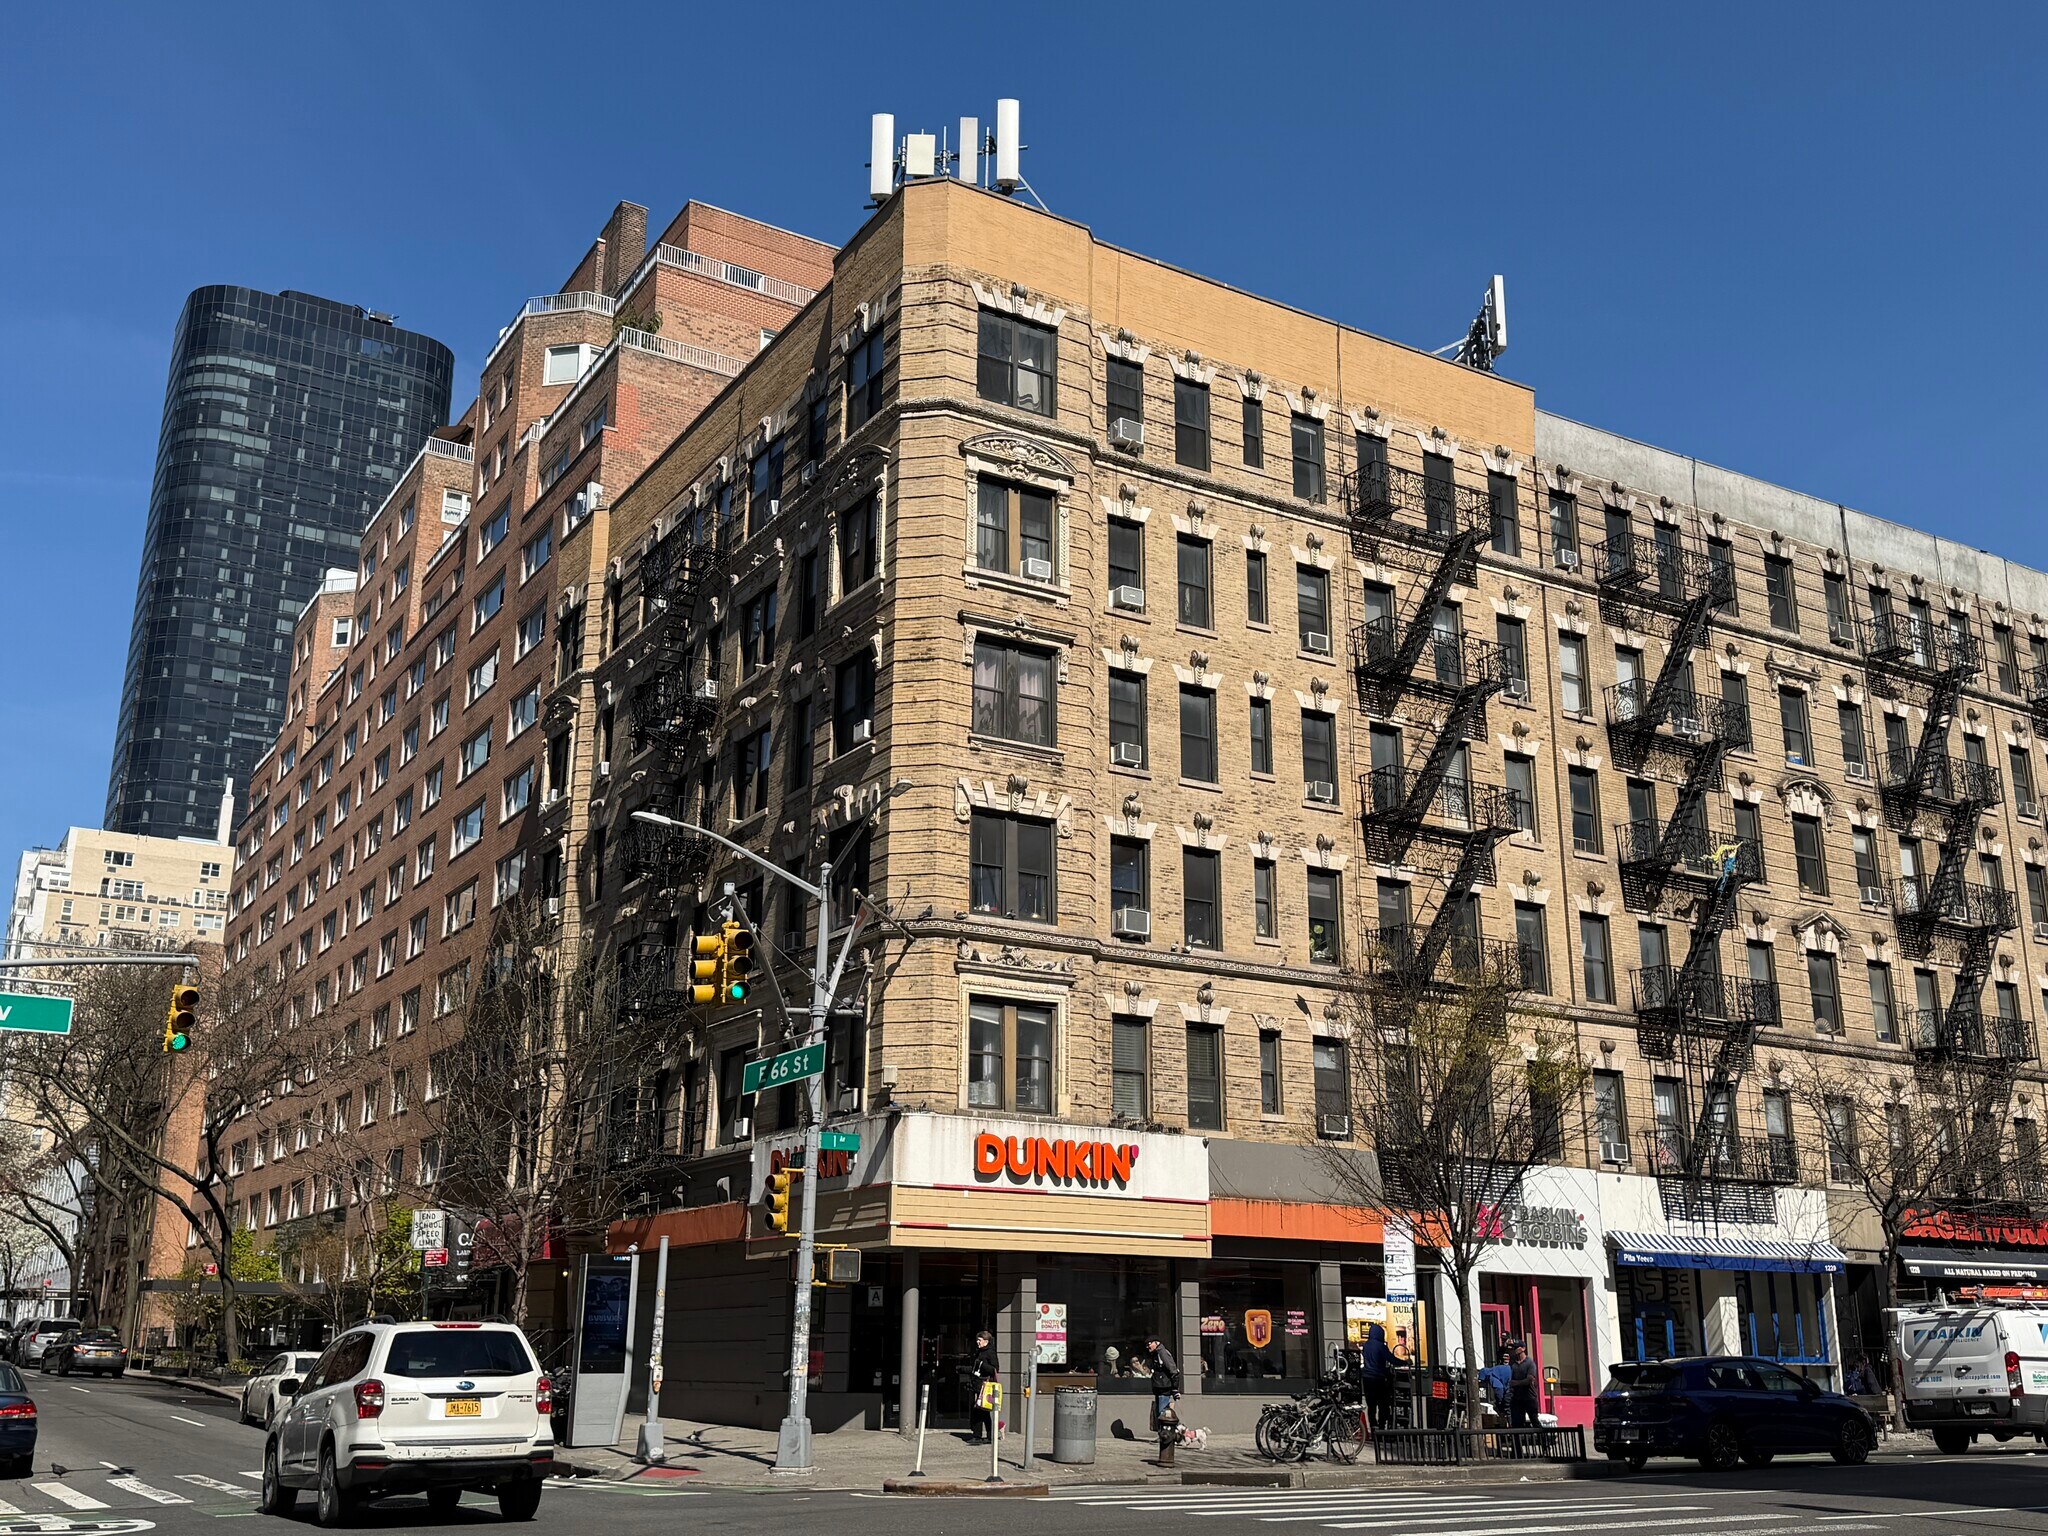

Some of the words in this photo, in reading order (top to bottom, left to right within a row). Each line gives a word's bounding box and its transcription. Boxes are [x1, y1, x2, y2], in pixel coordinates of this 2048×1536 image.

[759, 1065, 767, 1083] E
[771, 1060, 788, 1080] 66
[793, 1054, 809, 1073] St
[833, 1135, 837, 1147] 1
[977, 1133, 1140, 1182] DUNKIN'
[1520, 1206, 1577, 1223] BASKIN
[1521, 1224, 1588, 1243] ROBBINS
[1386, 1255, 1392, 1263] 2
[1623, 1253, 1636, 1262] Pita
[1955, 1268, 1982, 1276] NATURAL
[1982, 1269, 2001, 1277] BAKED
[872, 1291, 880, 1301] A
[1927, 1327, 1983, 1340] DAIKIN
